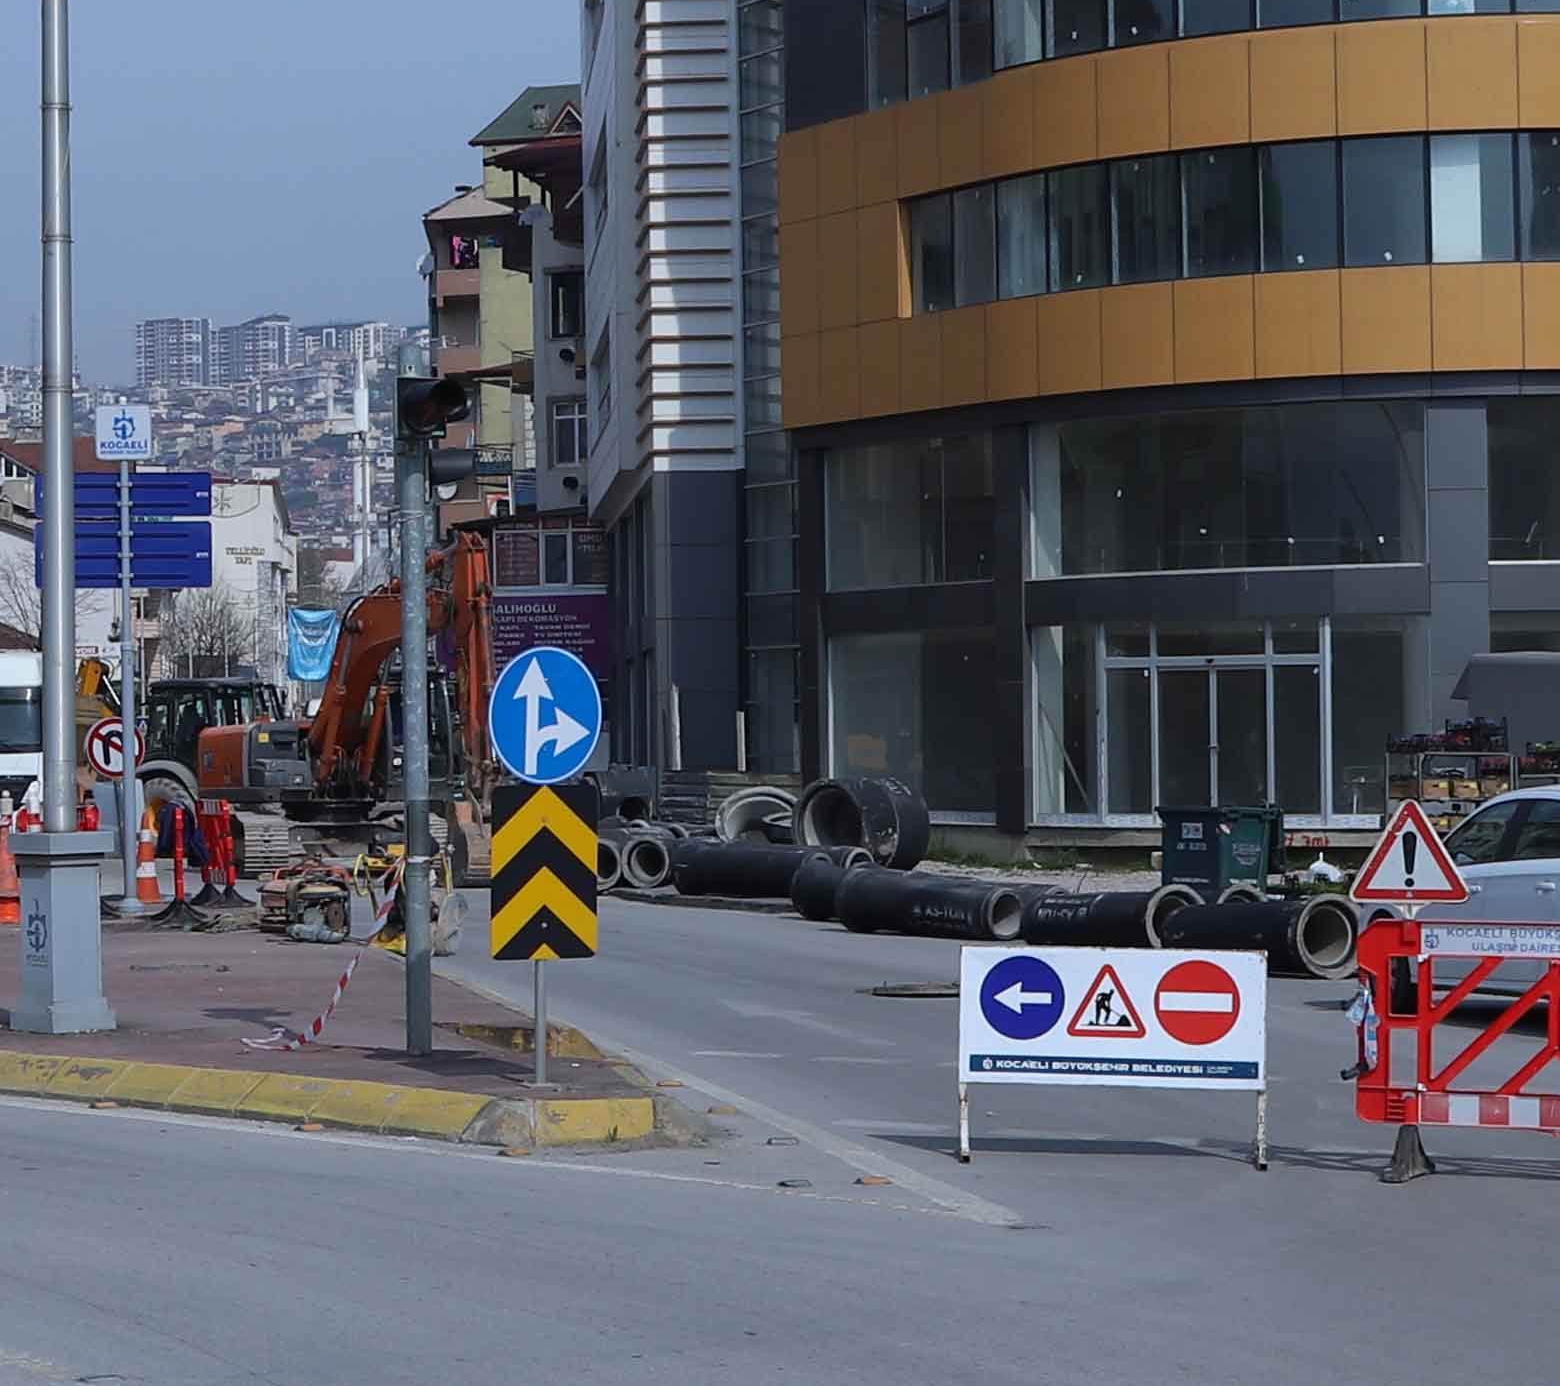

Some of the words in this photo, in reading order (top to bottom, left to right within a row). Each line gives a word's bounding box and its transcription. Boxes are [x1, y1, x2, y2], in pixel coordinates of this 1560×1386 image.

[100, 440, 147, 449] KOCAELİ
[1446, 926, 1504, 939] KOCAELİ
[996, 1059, 1049, 1070] KOCAELİ
[1052, 1061, 1130, 1073] BÜYÜKŞEHİR
[1132, 1063, 1203, 1074] BELEDİYESİ
